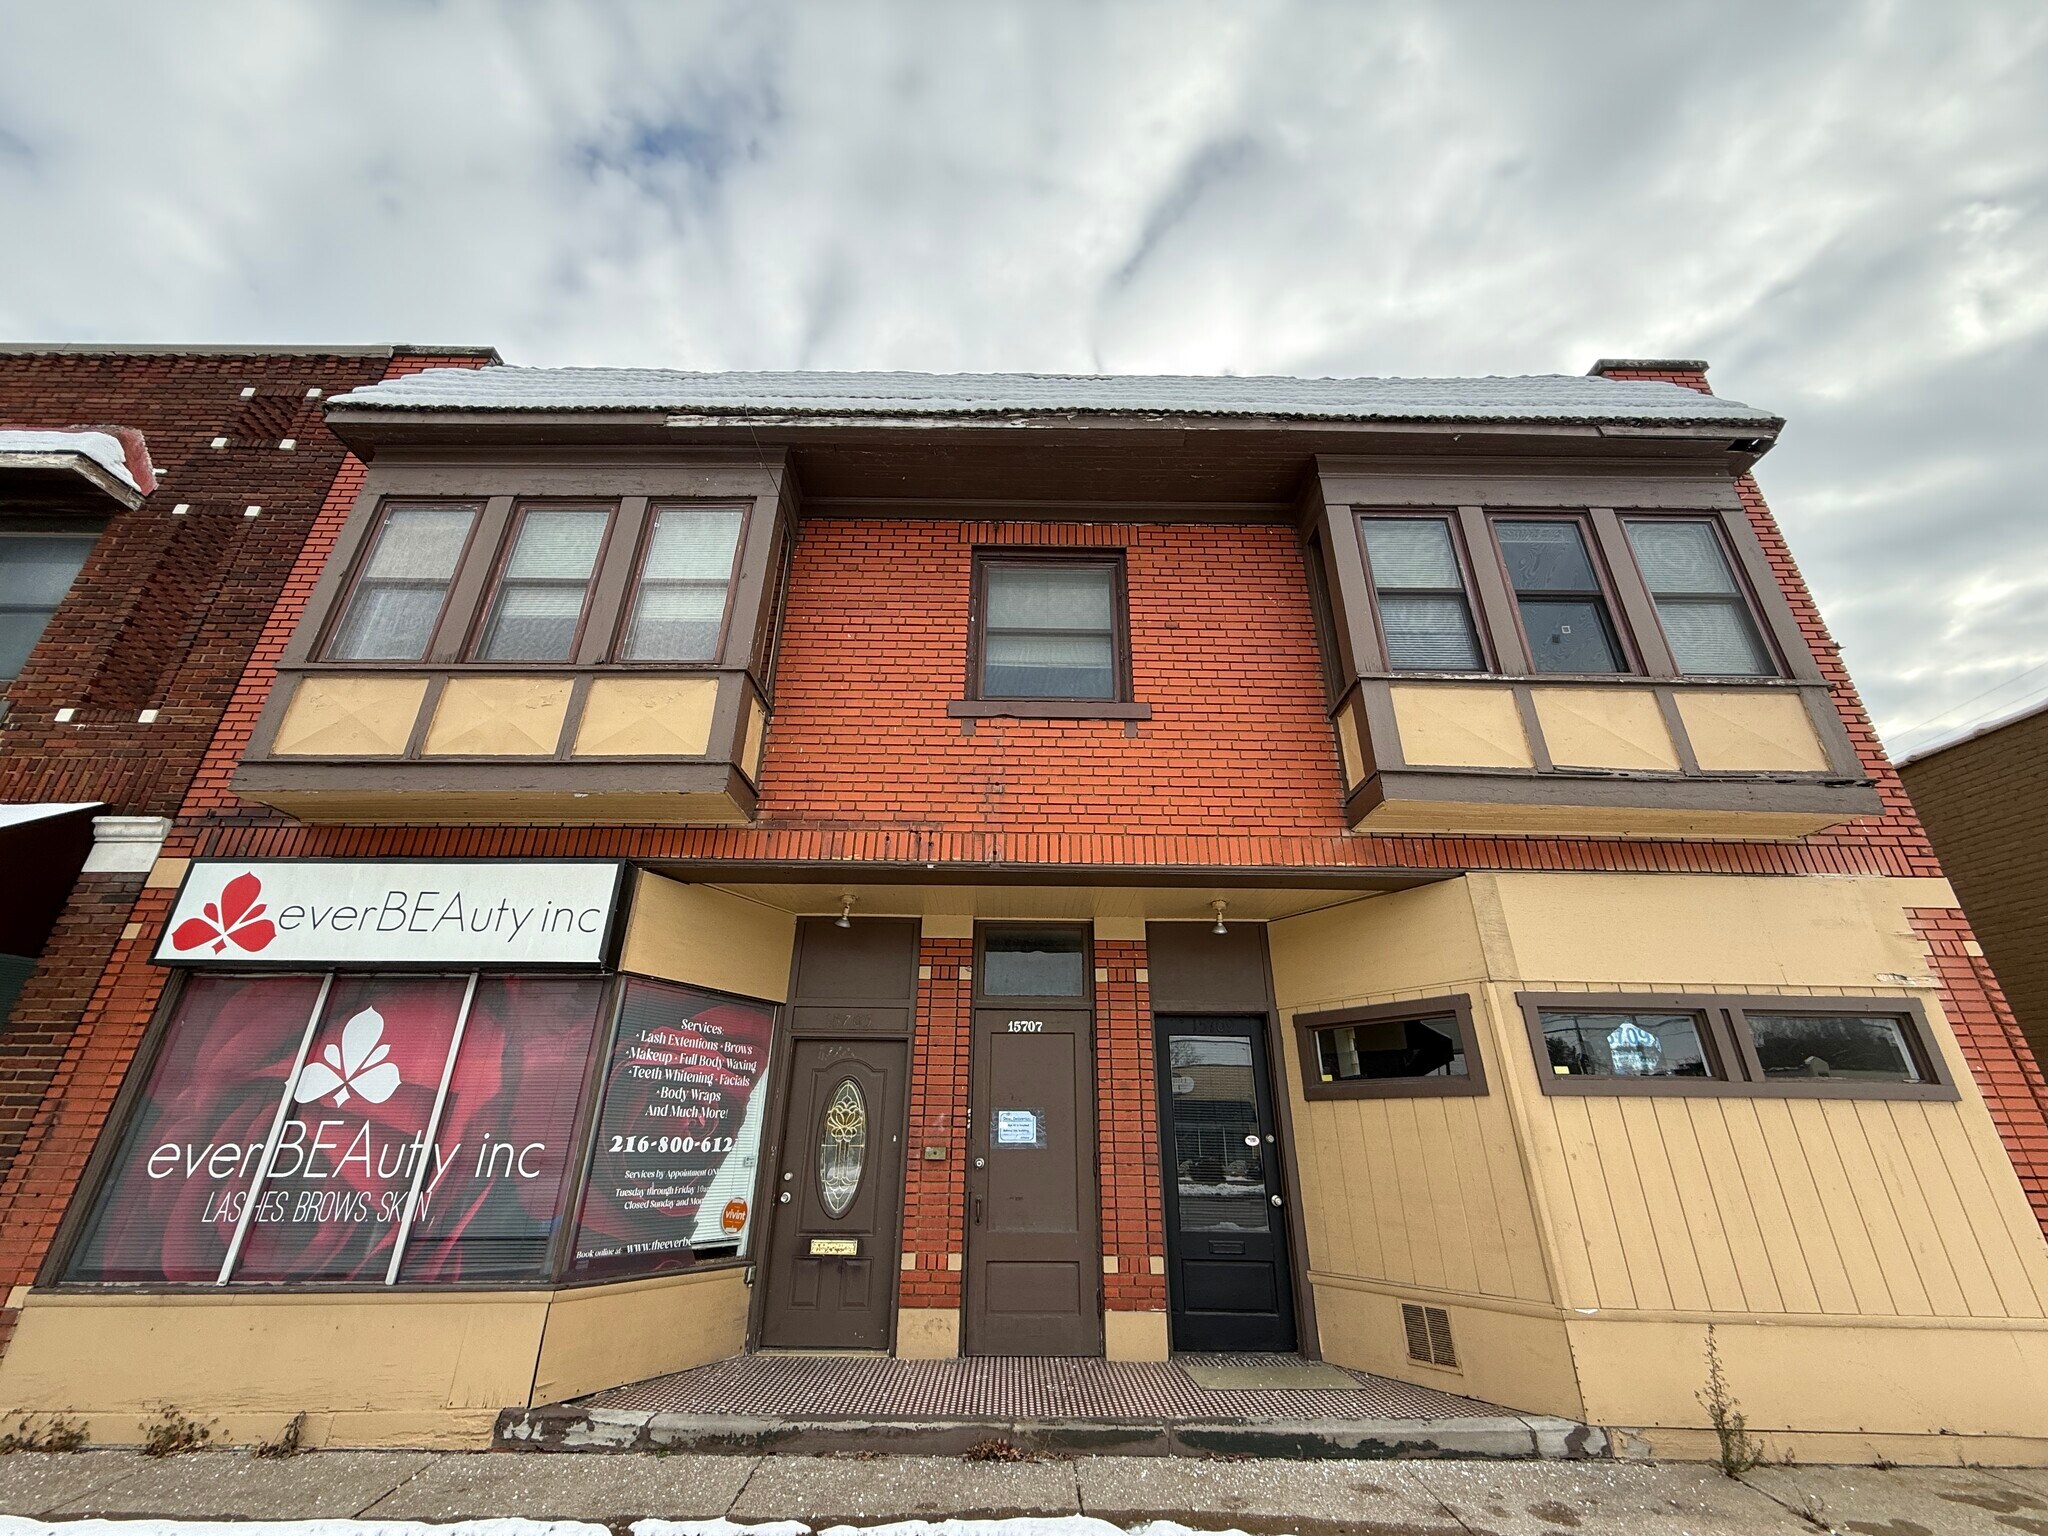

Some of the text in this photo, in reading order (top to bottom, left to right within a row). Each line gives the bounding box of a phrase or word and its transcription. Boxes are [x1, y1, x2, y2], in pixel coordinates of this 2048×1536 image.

[278, 890, 601, 943] everBEAuty inc
[681, 1018, 725, 1036] Services:
[1007, 1020, 1043, 1033] 15707
[641, 1029, 753, 1055] Lash Extentions Brows
[628, 1046, 758, 1075] Makeup Full Body Waxing
[632, 1065, 751, 1087] Teeth Whitening Facials
[660, 1086, 722, 1104] Body Wraps
[645, 1104, 729, 1119] And Much More!
[608, 1135, 738, 1154] 216-800-612
[146, 1119, 546, 1193] everBEAuty inc
[624, 1167, 720, 1180] Services by Appointment ON
[615, 1188, 646, 1198] Tuesday
[646, 1186, 675, 1197] through
[674, 1185, 696, 1195] Friday
[292, 1190, 371, 1223] BROWS.
[376, 1190, 432, 1223] SKN
[624, 1200, 649, 1210] Closed
[649, 1198, 676, 1208] Sunday
[675, 1198, 690, 1206] and
[725, 1208, 746, 1221] vivint
[576, 1249, 594, 1259] Book
[594, 1248, 614, 1257] online
